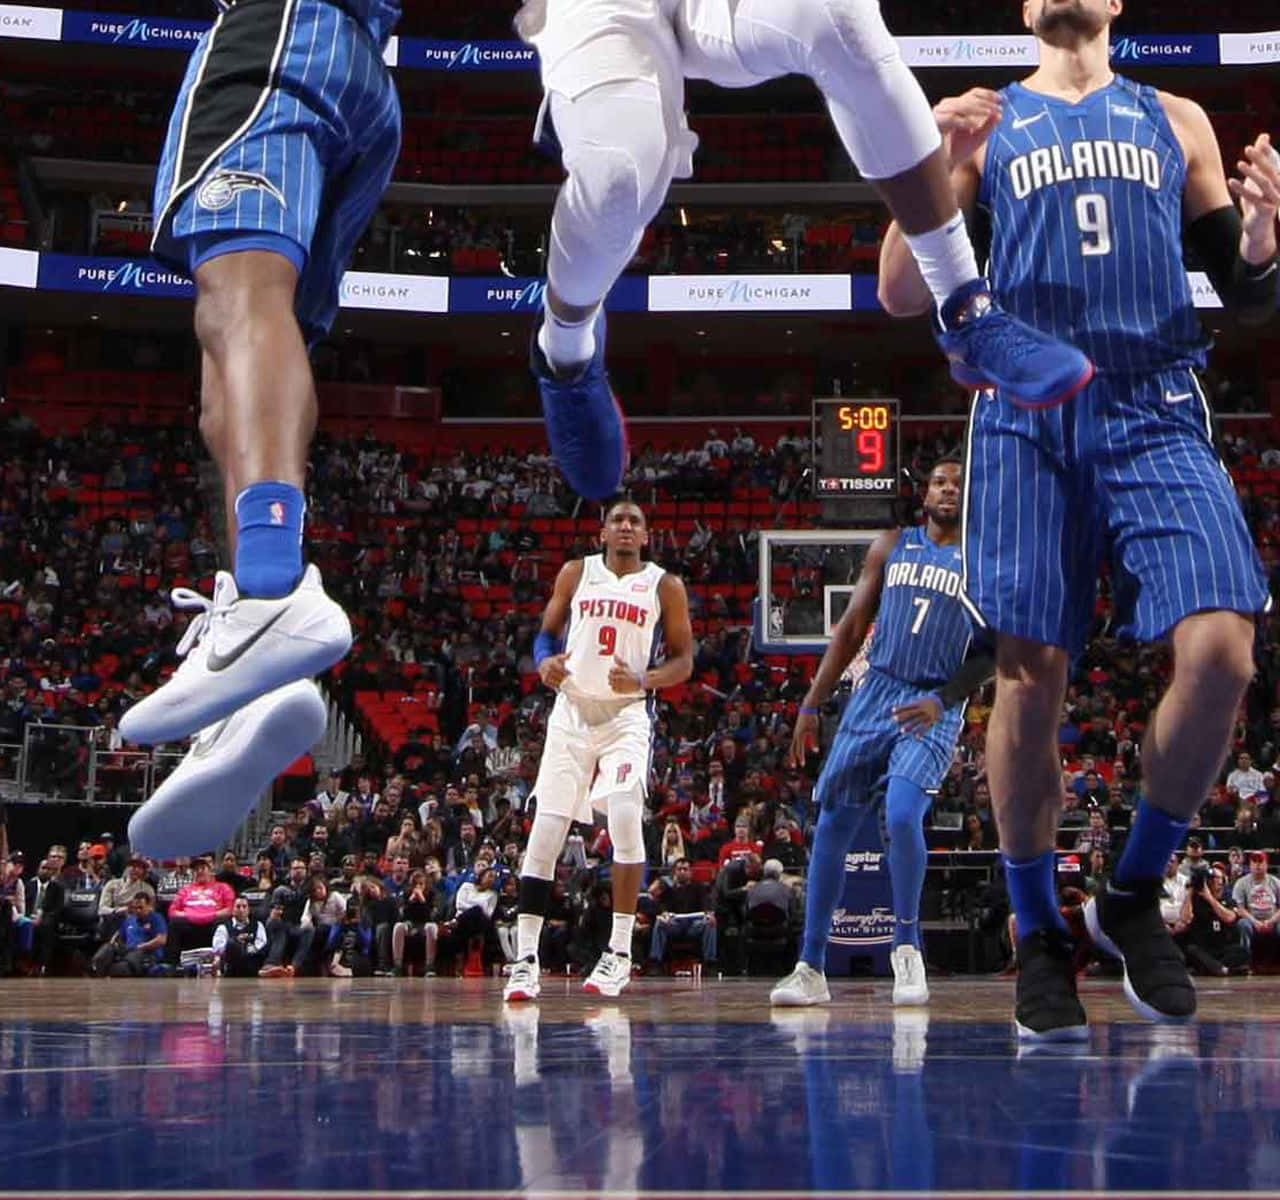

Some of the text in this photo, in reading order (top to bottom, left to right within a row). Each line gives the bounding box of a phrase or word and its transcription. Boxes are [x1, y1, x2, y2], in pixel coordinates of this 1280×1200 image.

[91, 19, 204, 44] PURE MICHIGAN
[426, 43, 535, 67] PURE MICHIGAN
[919, 38, 1029, 64] PURE MICHIGAN
[1111, 37, 1192, 60] MICHIGAN
[1249, 43, 1280, 54] PURE
[1009, 140, 1161, 200] ORLANDO
[1075, 193, 1111, 256] 9
[78, 262, 193, 293] PURE MICHIGA
[340, 278, 410, 299] ICHIGAN
[487, 289, 522, 301] PURE
[688, 281, 811, 307] PURE MICHIGAN
[839, 407, 888, 430] 5:00
[857, 430, 884, 473] 9
[839, 478, 895, 490] TISSOT
[887, 563, 961, 597] ORLAND
[578, 600, 648, 627] PISTONS
[911, 597, 930, 634] 7
[598, 626, 617, 656] 9
[845, 852, 882, 865] agstar
